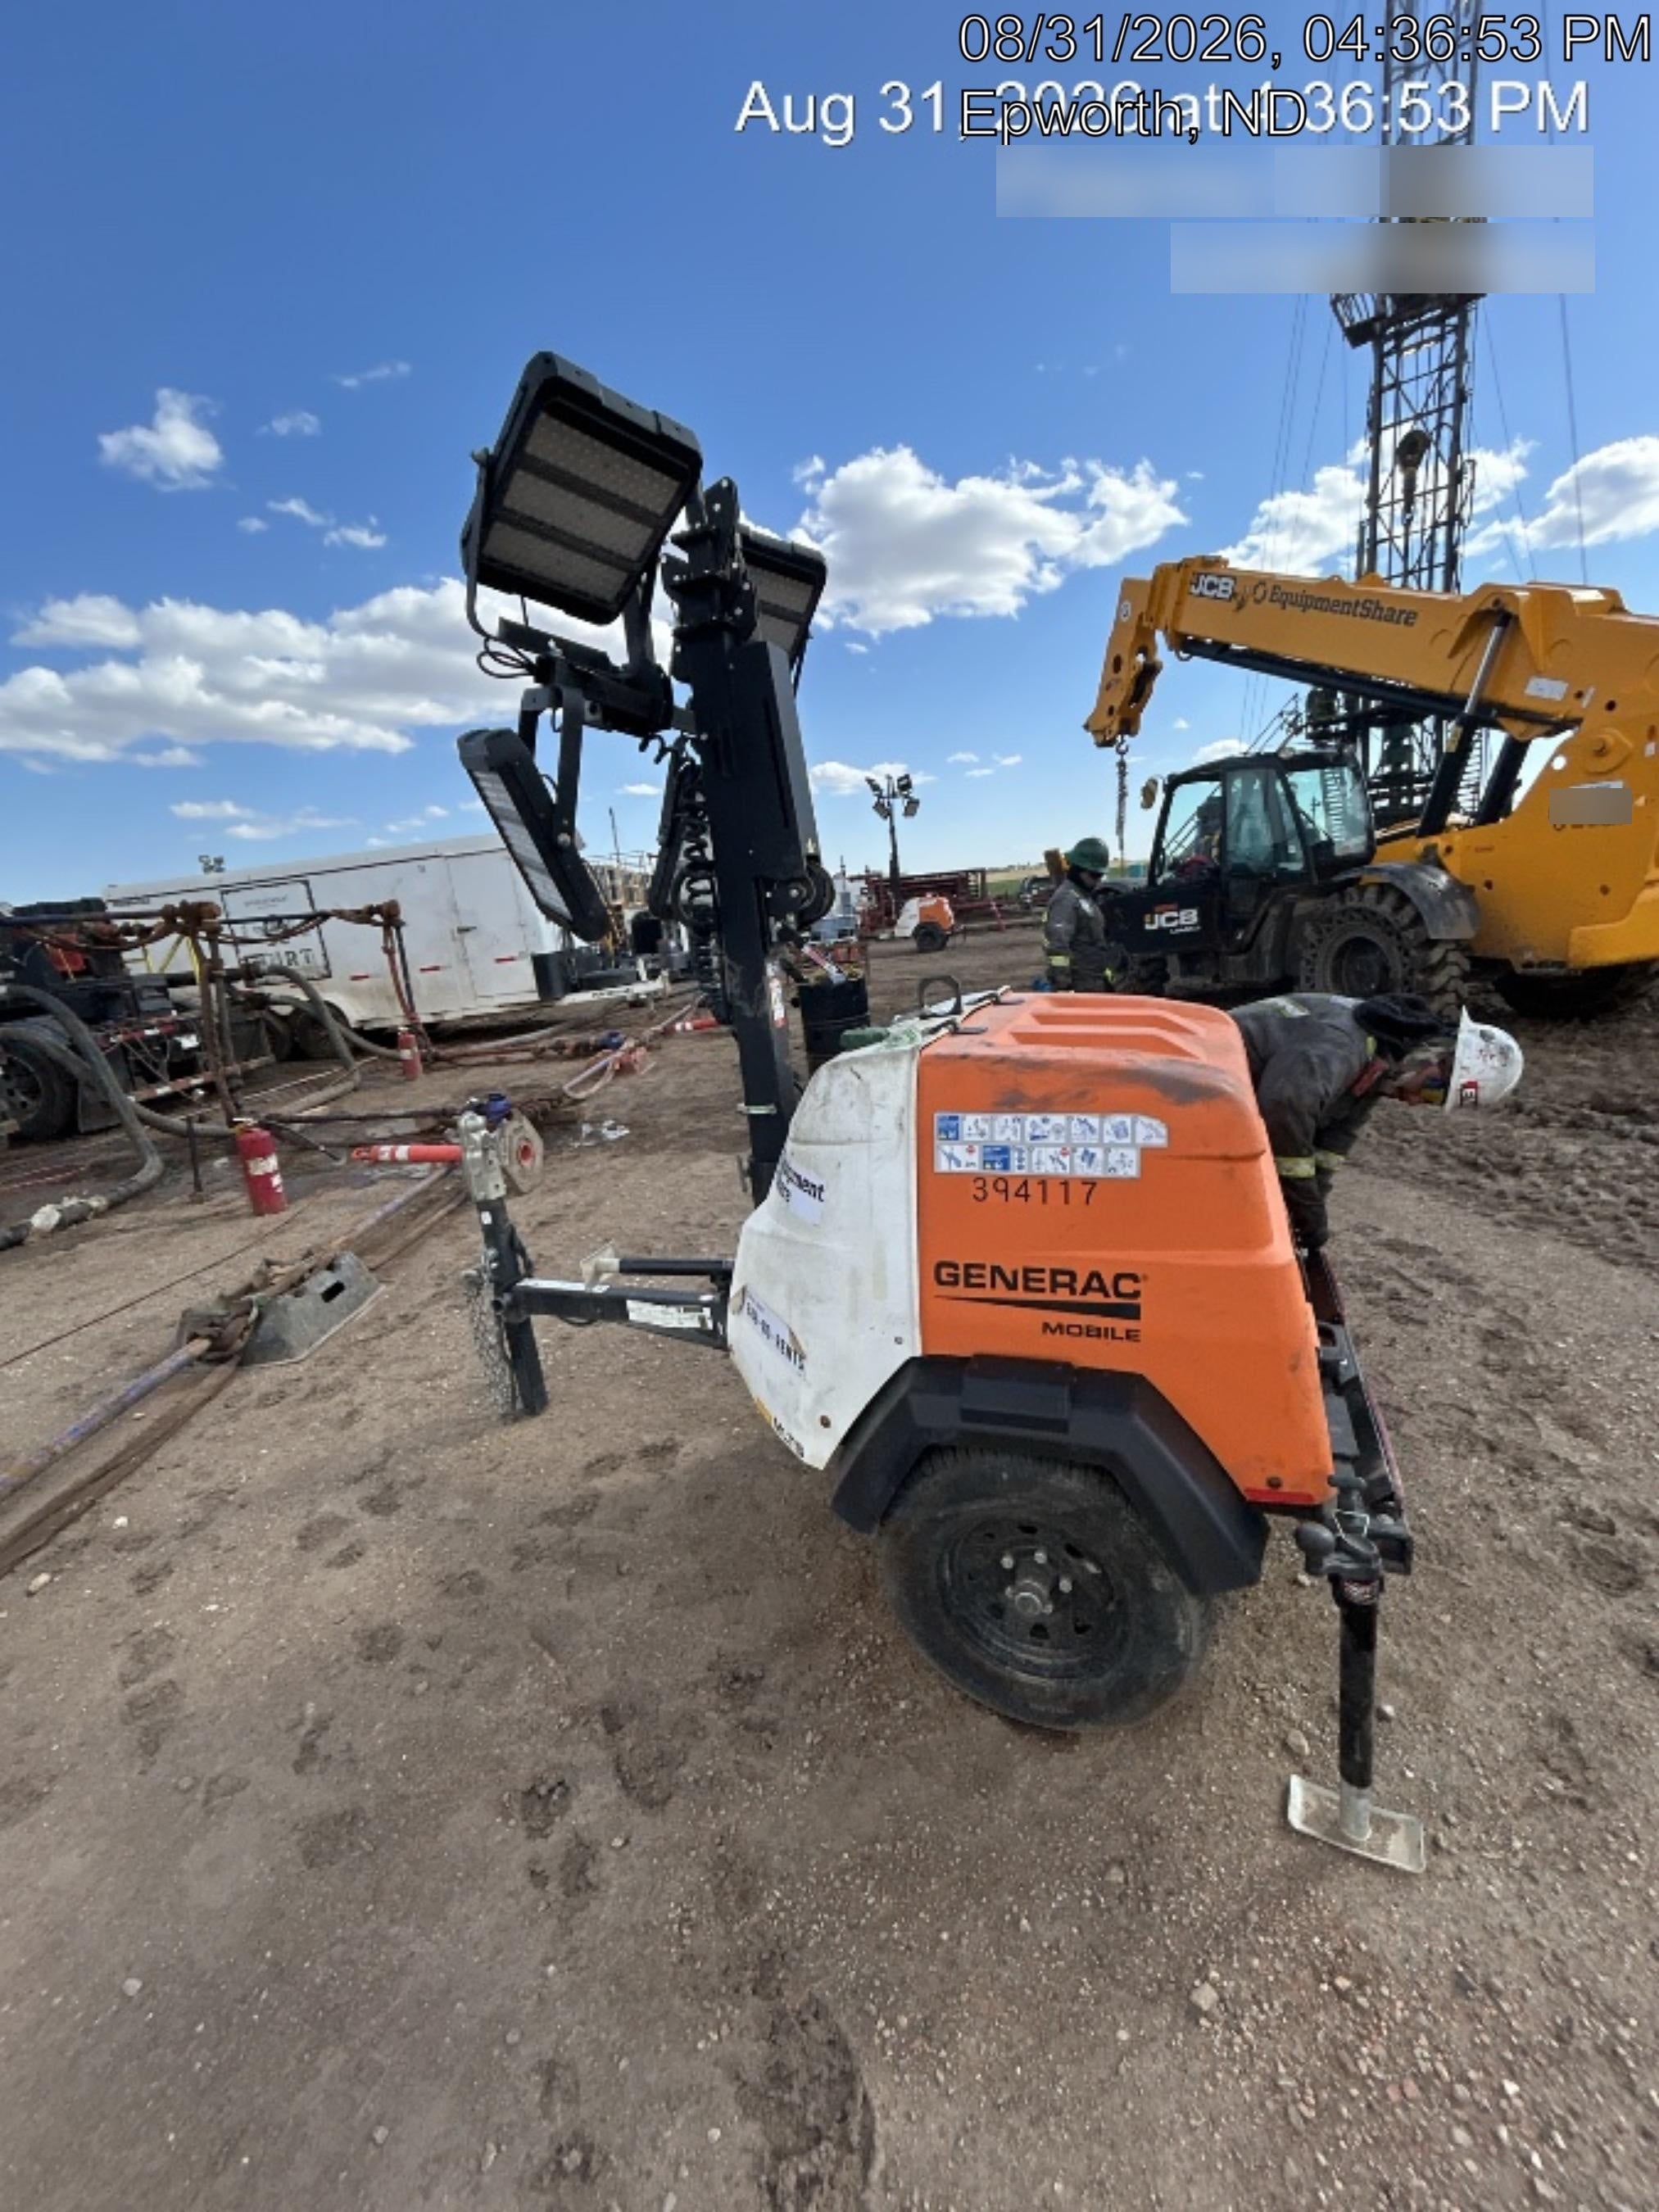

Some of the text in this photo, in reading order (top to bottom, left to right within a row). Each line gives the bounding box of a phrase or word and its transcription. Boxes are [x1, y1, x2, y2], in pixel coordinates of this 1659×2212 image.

[1189, 573, 1418, 627] JCB EquipmentShare
[1145, 908, 1199, 930] JCB
[972, 1177, 1098, 1205] 394117
[934, 1260, 1141, 1299] GENERAC
[1041, 1321, 1141, 1342] MOBILE
